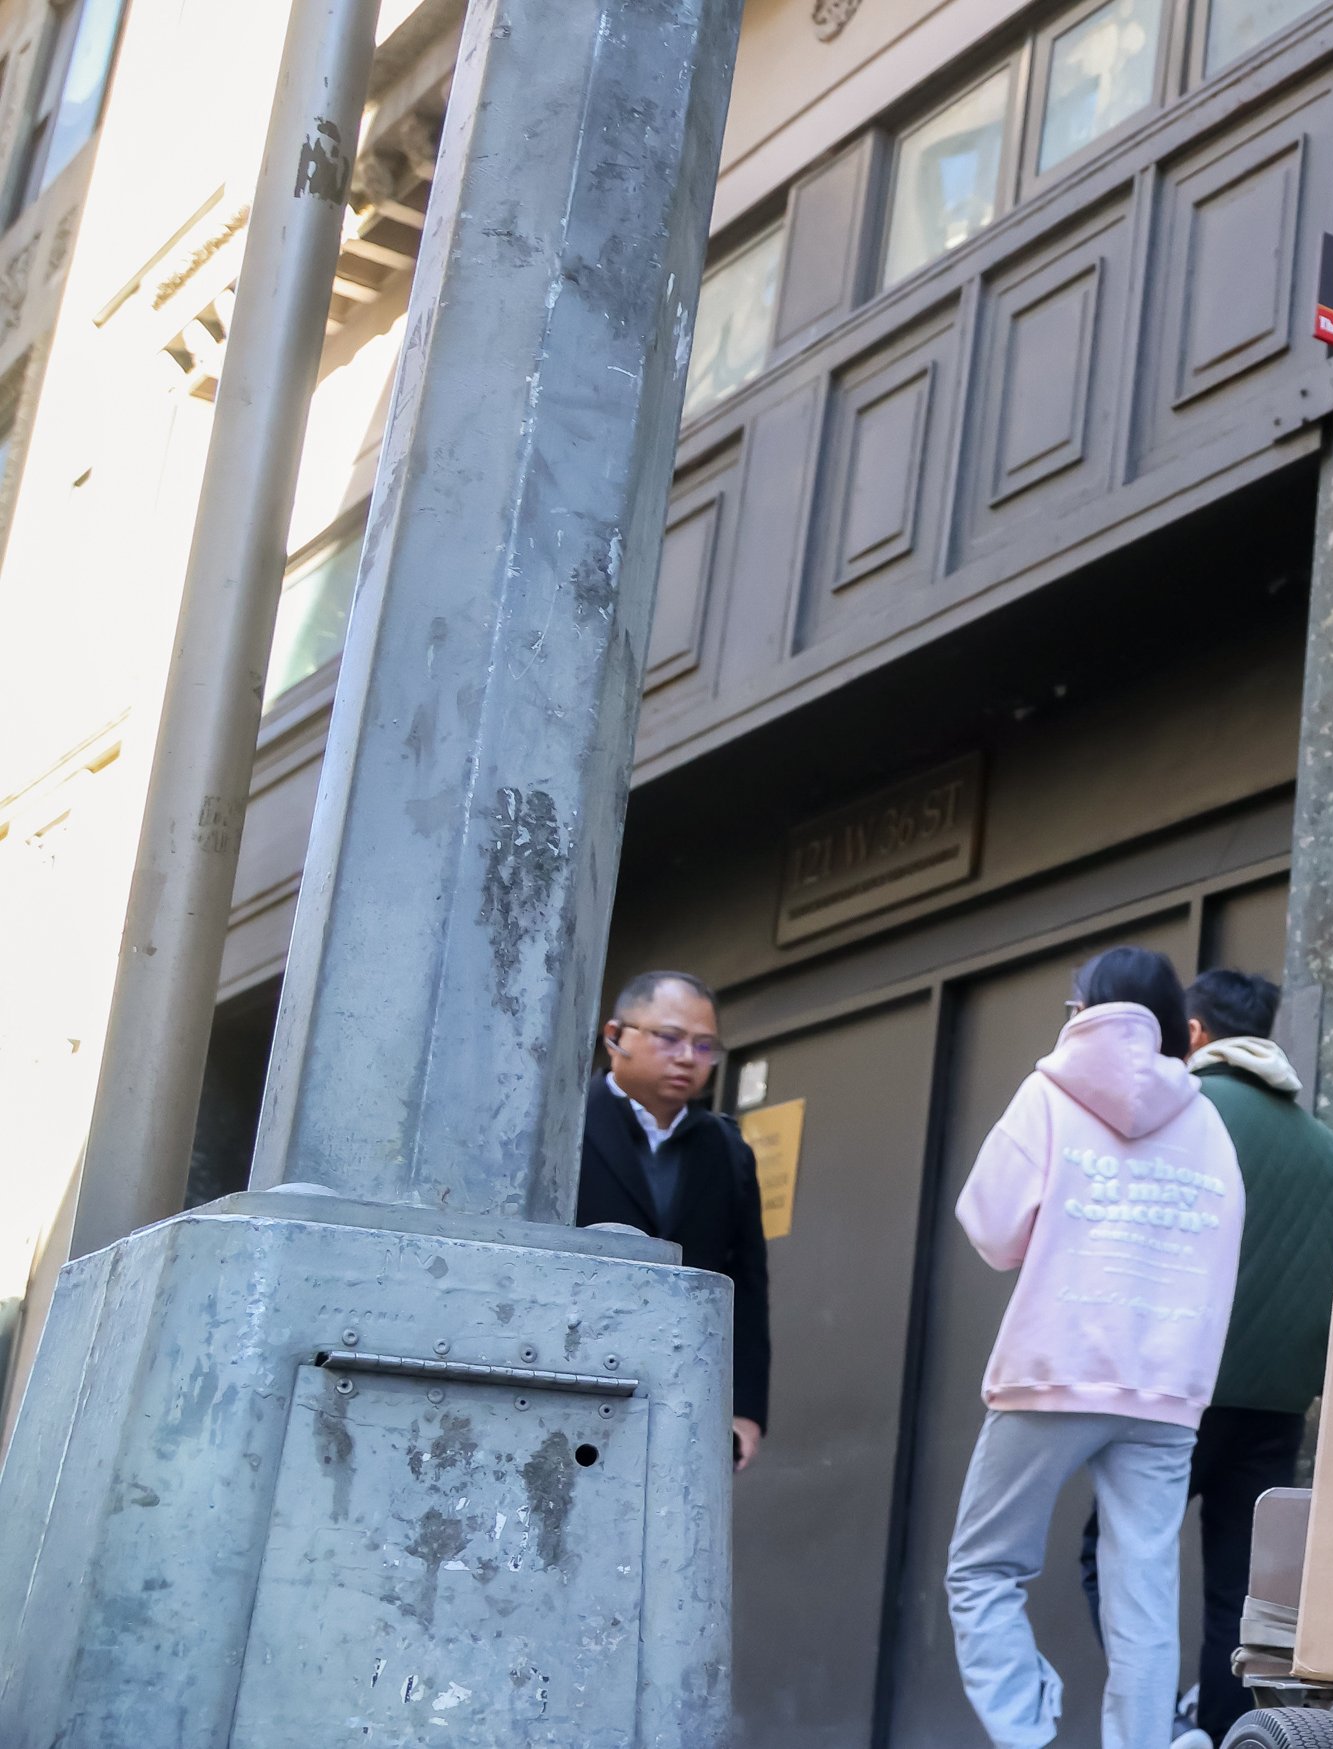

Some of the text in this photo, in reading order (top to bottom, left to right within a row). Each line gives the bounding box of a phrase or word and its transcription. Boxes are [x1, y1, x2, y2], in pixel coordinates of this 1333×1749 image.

[1091, 1174, 1199, 1210] it may
[1125, 1157, 1226, 1196] whom
